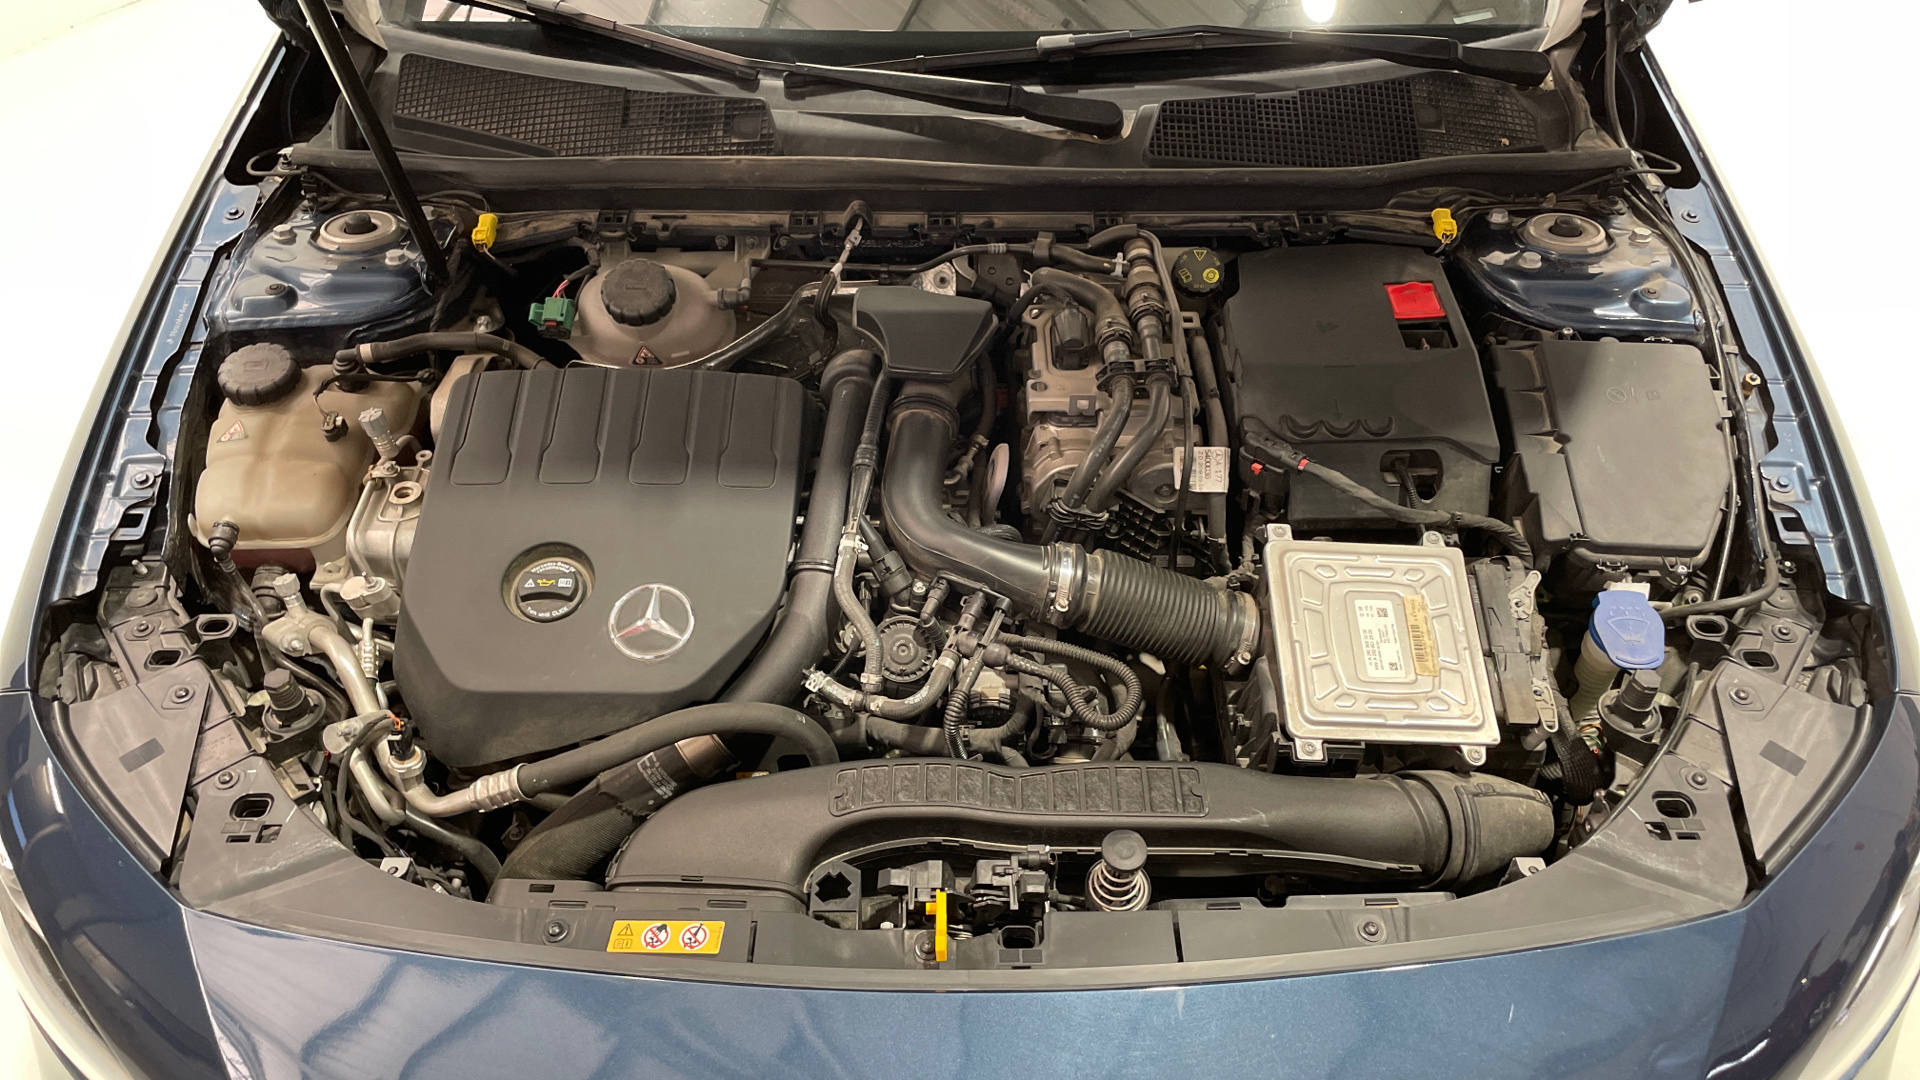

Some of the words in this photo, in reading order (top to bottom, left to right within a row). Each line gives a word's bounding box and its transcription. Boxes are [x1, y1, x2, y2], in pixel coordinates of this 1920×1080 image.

[1215, 469, 1223, 484] 177
[527, 606, 537, 616] Turn
[551, 606, 569, 617] CLICK
